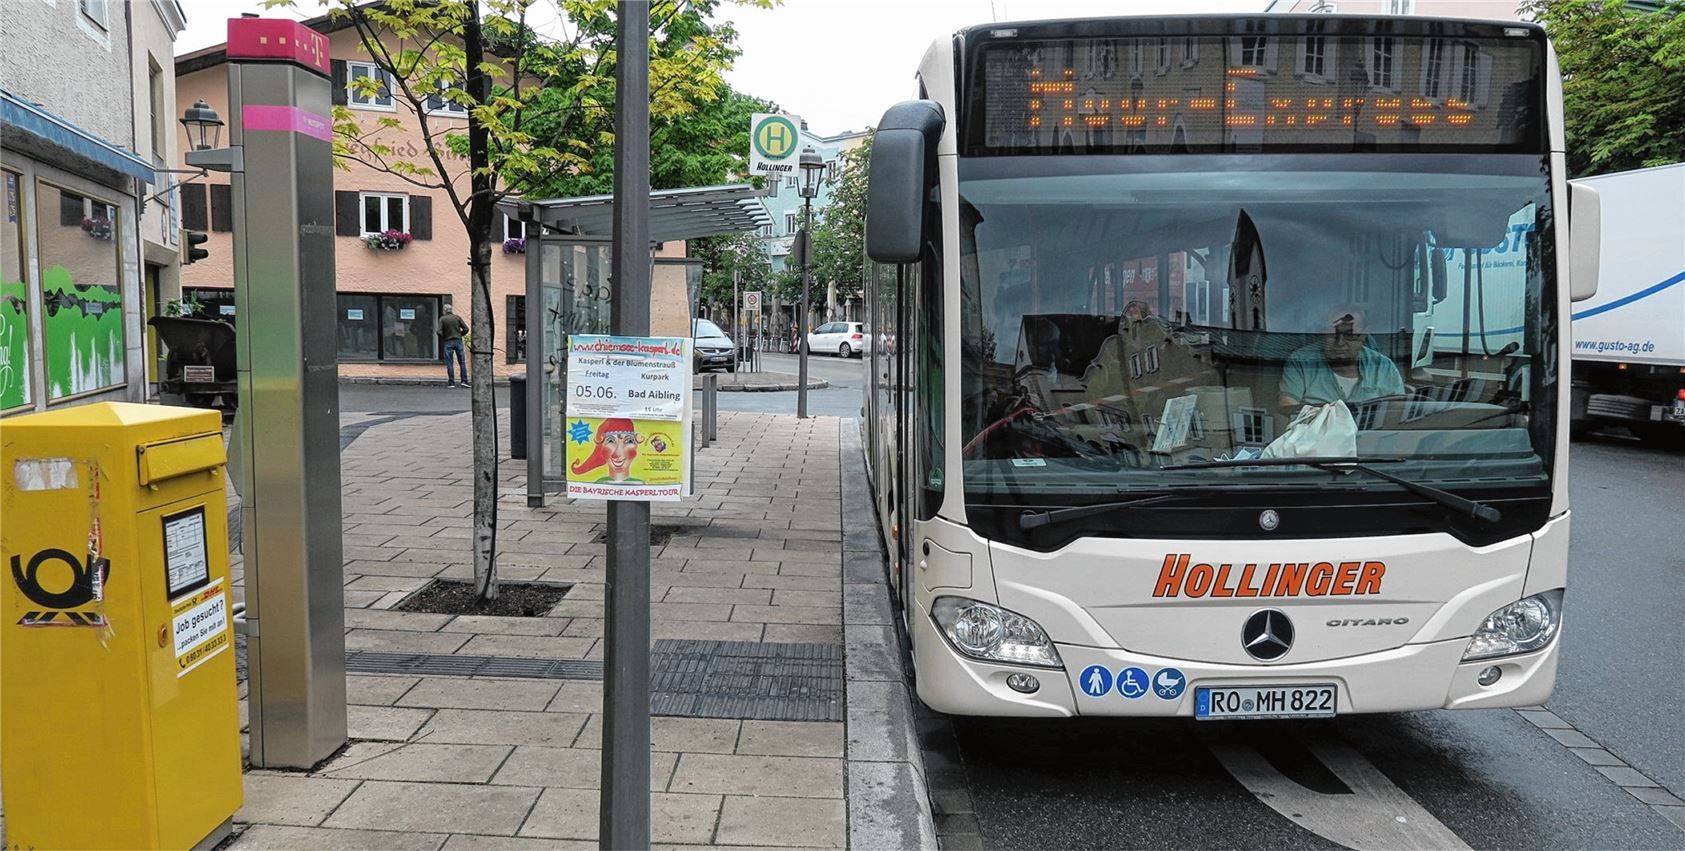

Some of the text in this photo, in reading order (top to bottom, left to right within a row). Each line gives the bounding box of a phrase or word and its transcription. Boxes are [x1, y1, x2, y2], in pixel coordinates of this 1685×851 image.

[767, 126, 785, 151] H
[573, 339, 681, 356] www.chiemsee-kasperl.de
[1575, 340, 1655, 354] www.gusto-ag.de
[578, 358, 604, 367] Kasperl
[613, 359, 625, 367] der
[626, 360, 676, 368] Blumenstrauß
[585, 370, 610, 379] Freitag
[641, 373, 670, 381] Kurpark
[576, 385, 617, 399] 05.06.
[628, 389, 681, 401] Bad Aibling
[583, 487, 623, 495] BAYRISCHE
[1152, 554, 1386, 598] HOLLINGER
[175, 619, 190, 634] Job
[200, 627, 208, 637] Sie
[208, 622, 217, 631] mit
[1211, 689, 1333, 713] RO MH 822
